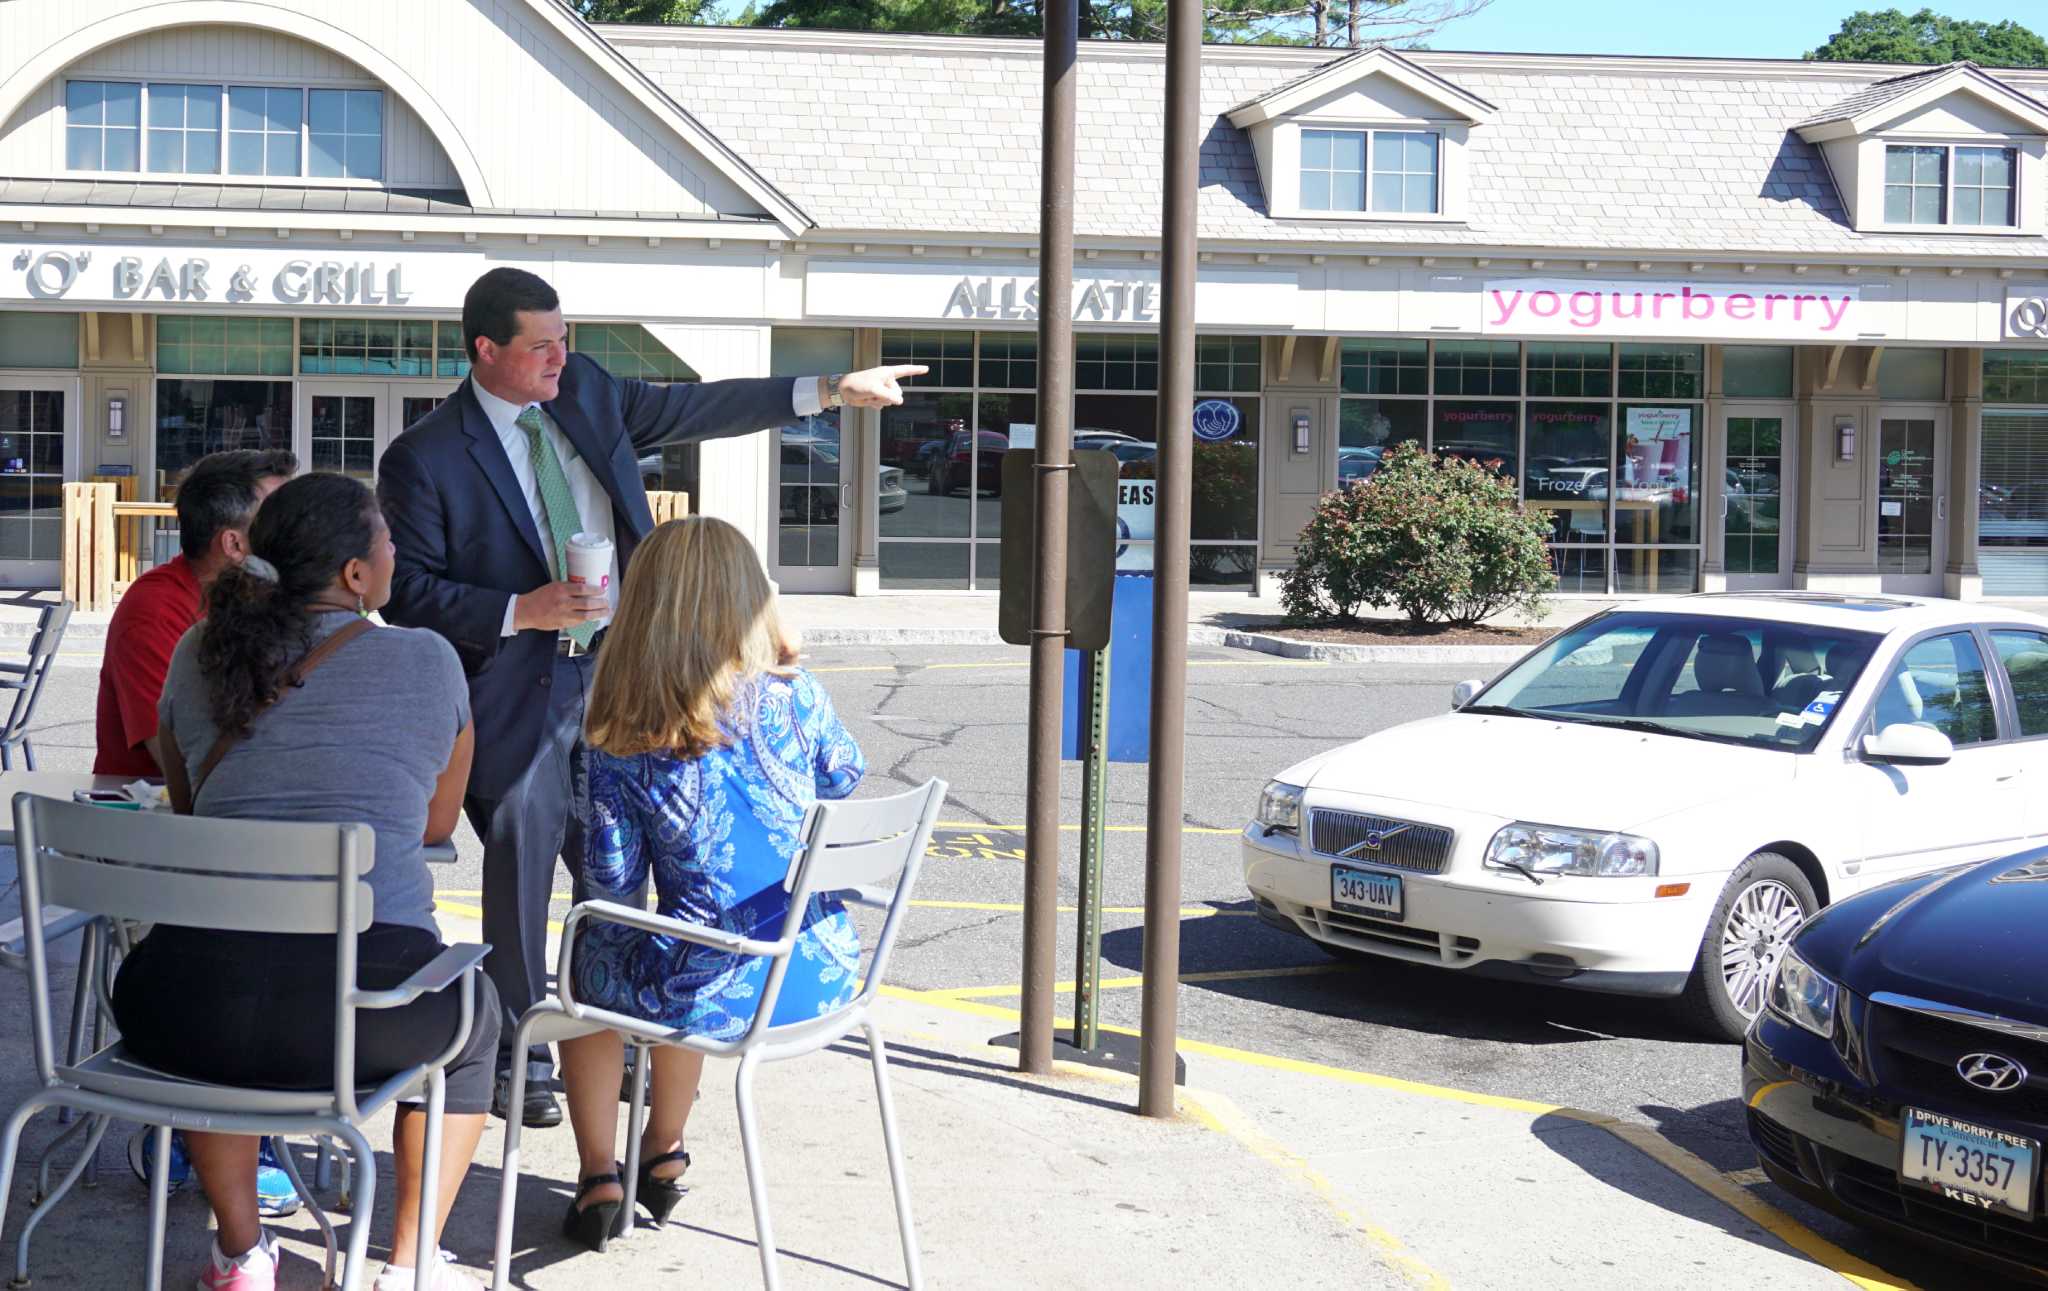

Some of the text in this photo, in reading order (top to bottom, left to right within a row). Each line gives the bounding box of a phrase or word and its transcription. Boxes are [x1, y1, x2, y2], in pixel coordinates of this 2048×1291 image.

[113, 256, 211, 300] BAR
[227, 264, 258, 301] &
[272, 260, 413, 303] GRILL
[942, 277, 1160, 320] ALLSATE
[1490, 286, 1852, 331] yogurberry
[1119, 485, 1154, 505] EAS
[1952, 1120, 1994, 1140] WORRY
[1997, 1132, 2028, 1149] FREE
[1945, 1187, 1993, 1209] KEY
